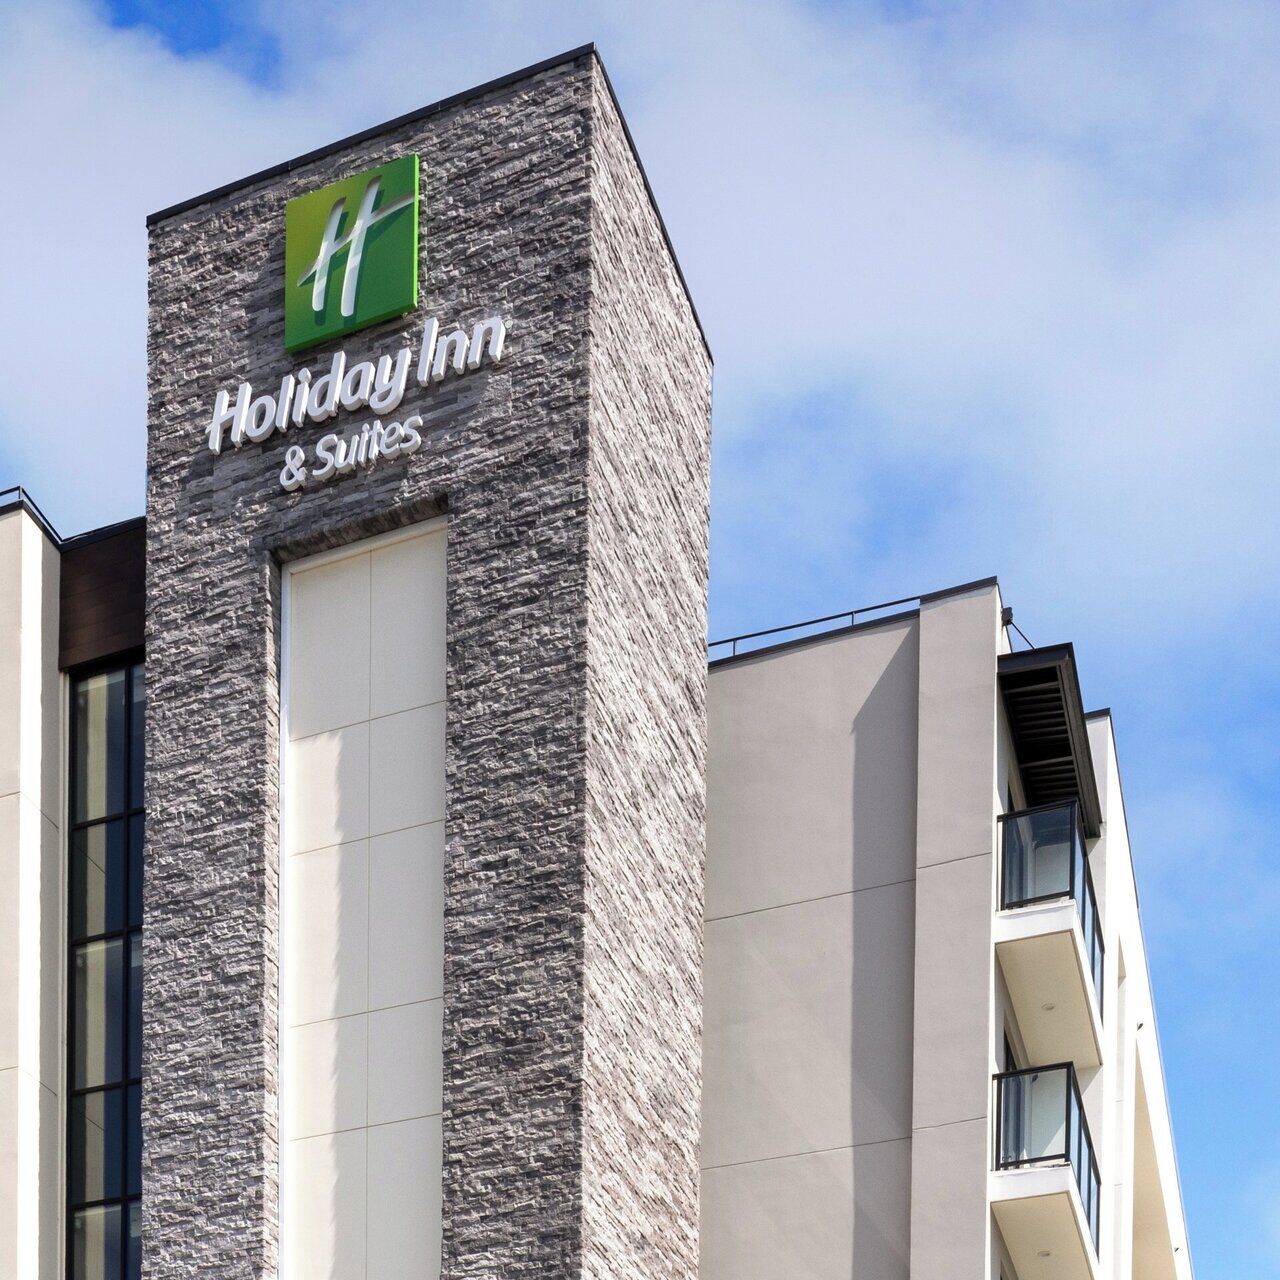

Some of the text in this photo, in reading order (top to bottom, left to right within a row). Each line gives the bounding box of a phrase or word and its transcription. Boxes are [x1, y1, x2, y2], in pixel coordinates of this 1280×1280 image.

[205, 316, 507, 455] Holiday Inn
[280, 415, 423, 492] & Suites
